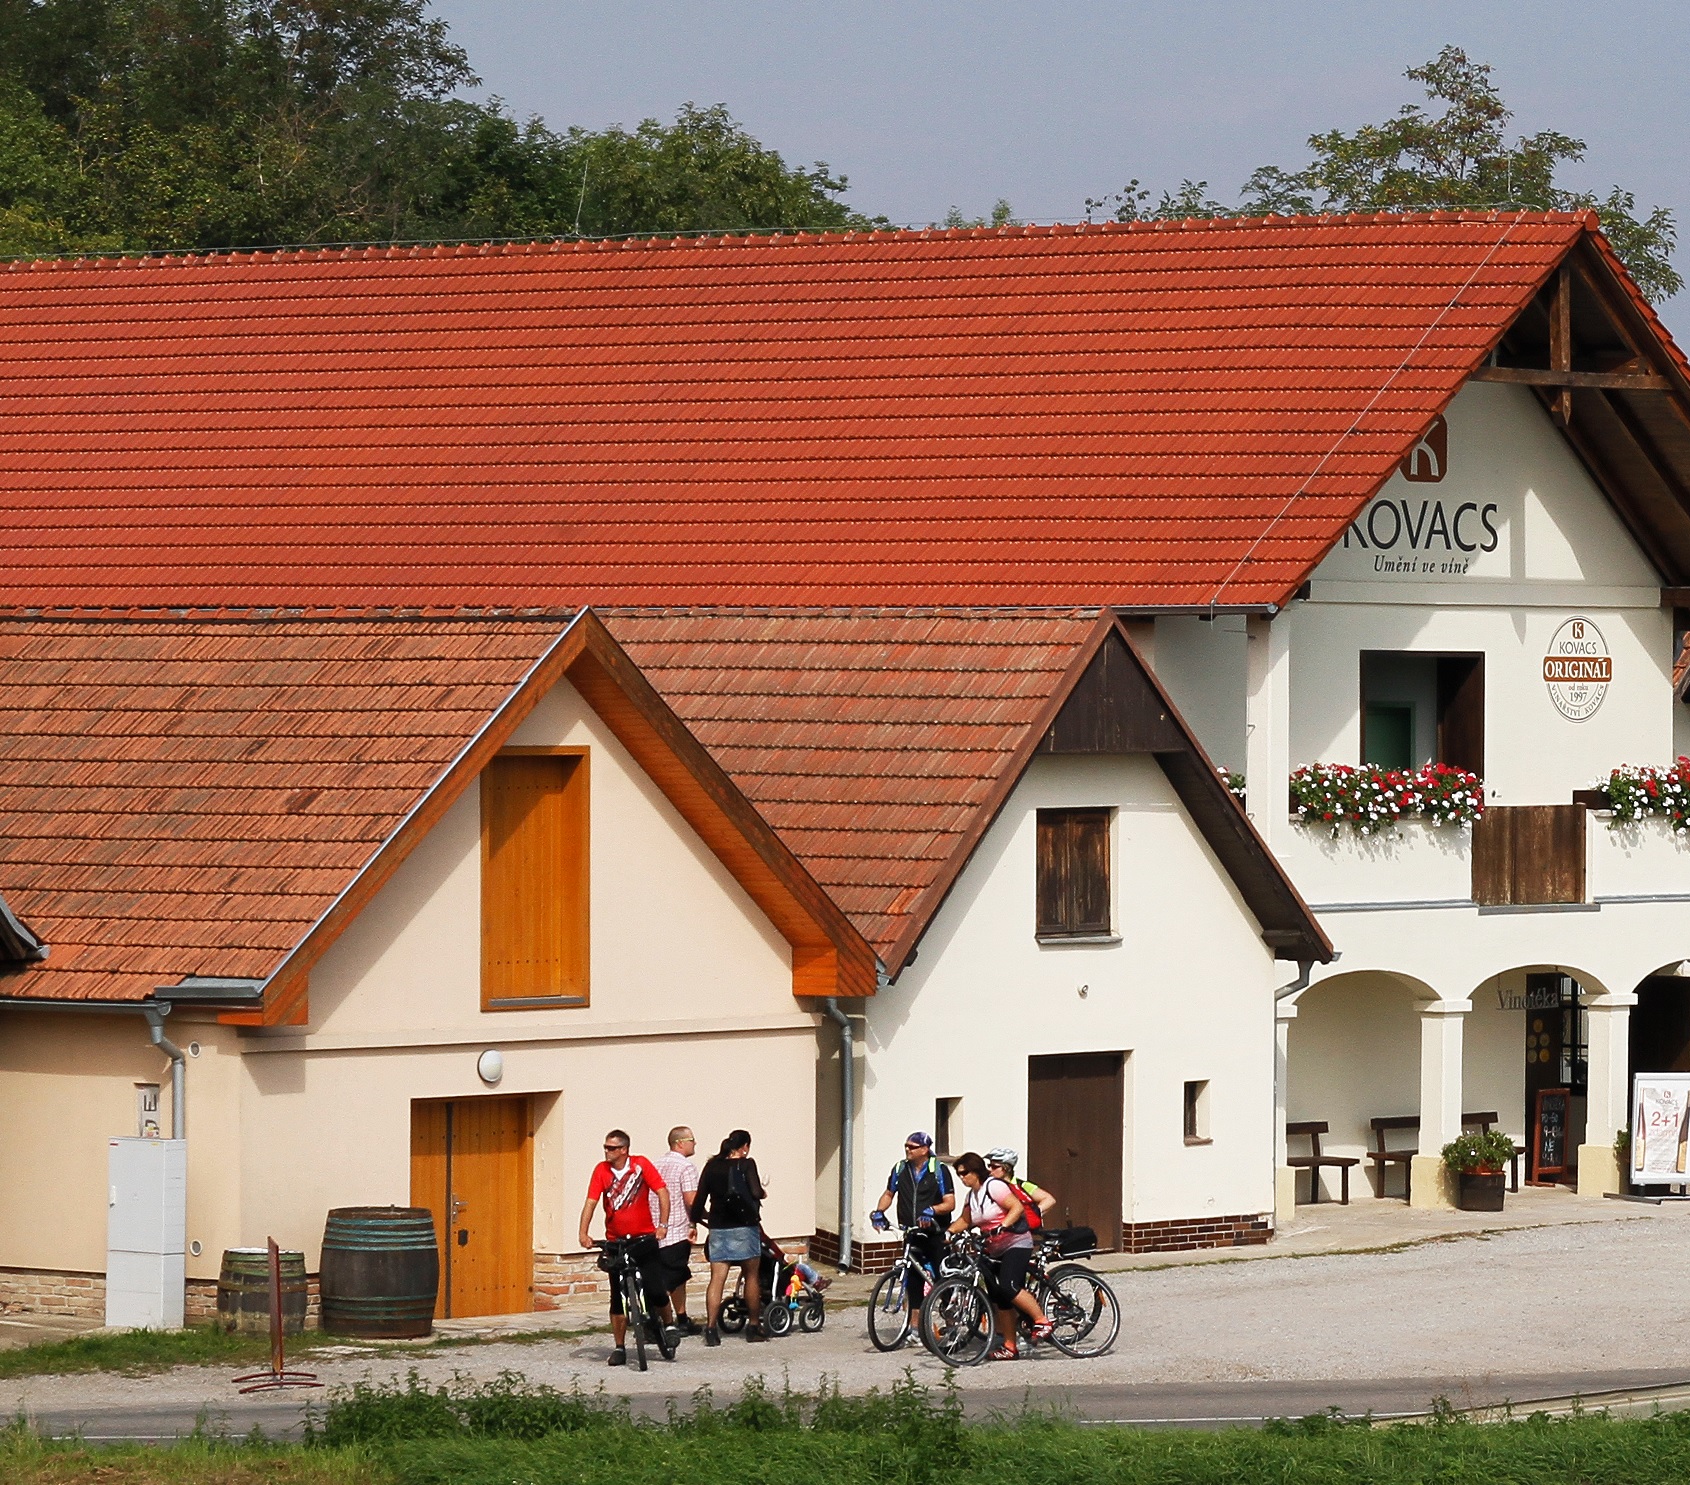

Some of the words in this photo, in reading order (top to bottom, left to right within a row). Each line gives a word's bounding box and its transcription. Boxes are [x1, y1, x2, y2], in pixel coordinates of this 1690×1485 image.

[1374, 554, 1418, 573] Umění
[1422, 562, 1436, 573] ve
[1440, 556, 1470, 575] víně
[1559, 641, 1597, 655] KOVACS
[1544, 658, 1611, 679] ORIGINÁL
[1570, 692, 1588, 702] 1997
[1651, 1111, 1679, 1128] 2+1
